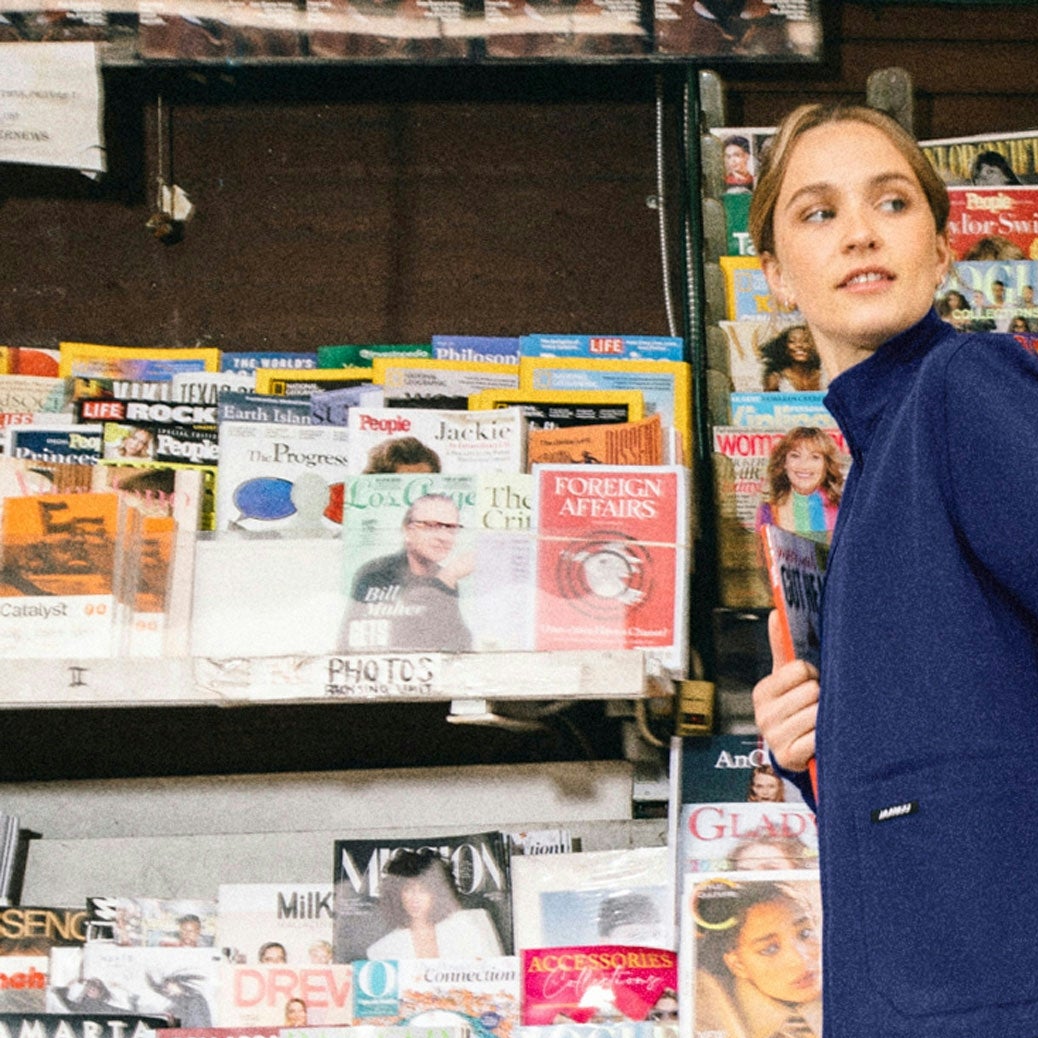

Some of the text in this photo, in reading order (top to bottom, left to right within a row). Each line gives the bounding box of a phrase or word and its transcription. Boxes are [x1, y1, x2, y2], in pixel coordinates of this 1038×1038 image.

[966, 193, 1014, 213] People
[590, 338, 623, 353] LIFE
[234, 358, 315, 369] THE WORLD'S
[84, 402, 217, 423] LIFE ROCK
[224, 406, 267, 422] Earth
[359, 414, 411, 435] People
[434, 420, 511, 440] Jackie
[157, 434, 218, 463] People
[250, 448, 272, 463] The
[344, 480, 402, 510] Los
[554, 476, 664, 499] FOREIGN
[558, 498, 657, 520] AFFAIRS
[364, 585, 401, 602] Bill
[0, 603, 68, 618] Catalyst
[328, 657, 434, 684] PHOTOS
[341, 840, 503, 898] MION
[527, 951, 674, 974] ACCESSORIES
[423, 966, 516, 984] Connection
[542, 964, 664, 1000] Collections
